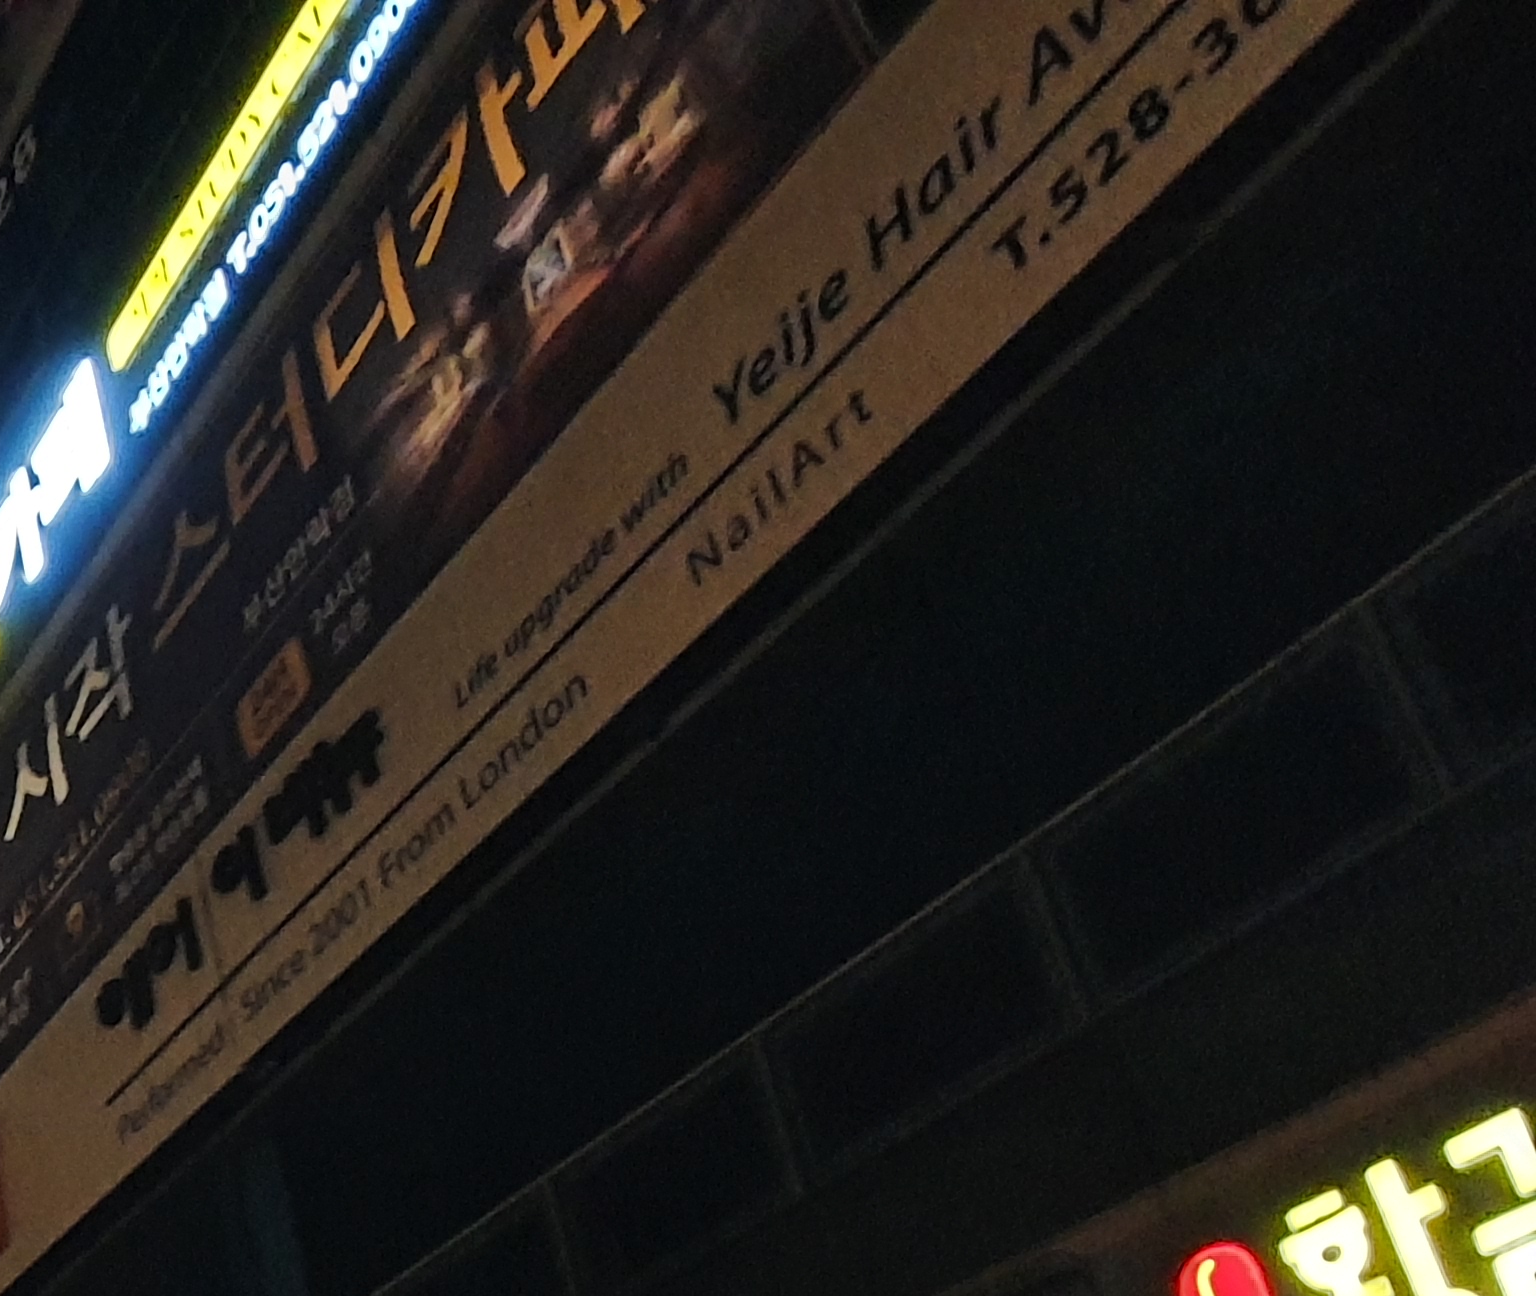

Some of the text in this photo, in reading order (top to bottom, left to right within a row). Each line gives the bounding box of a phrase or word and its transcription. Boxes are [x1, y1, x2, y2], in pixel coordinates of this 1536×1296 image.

[711, 265, 852, 425] Yeije
[864, 92, 1003, 270] Hair
[616, 450, 691, 535] with
[456, 672, 592, 812] London
